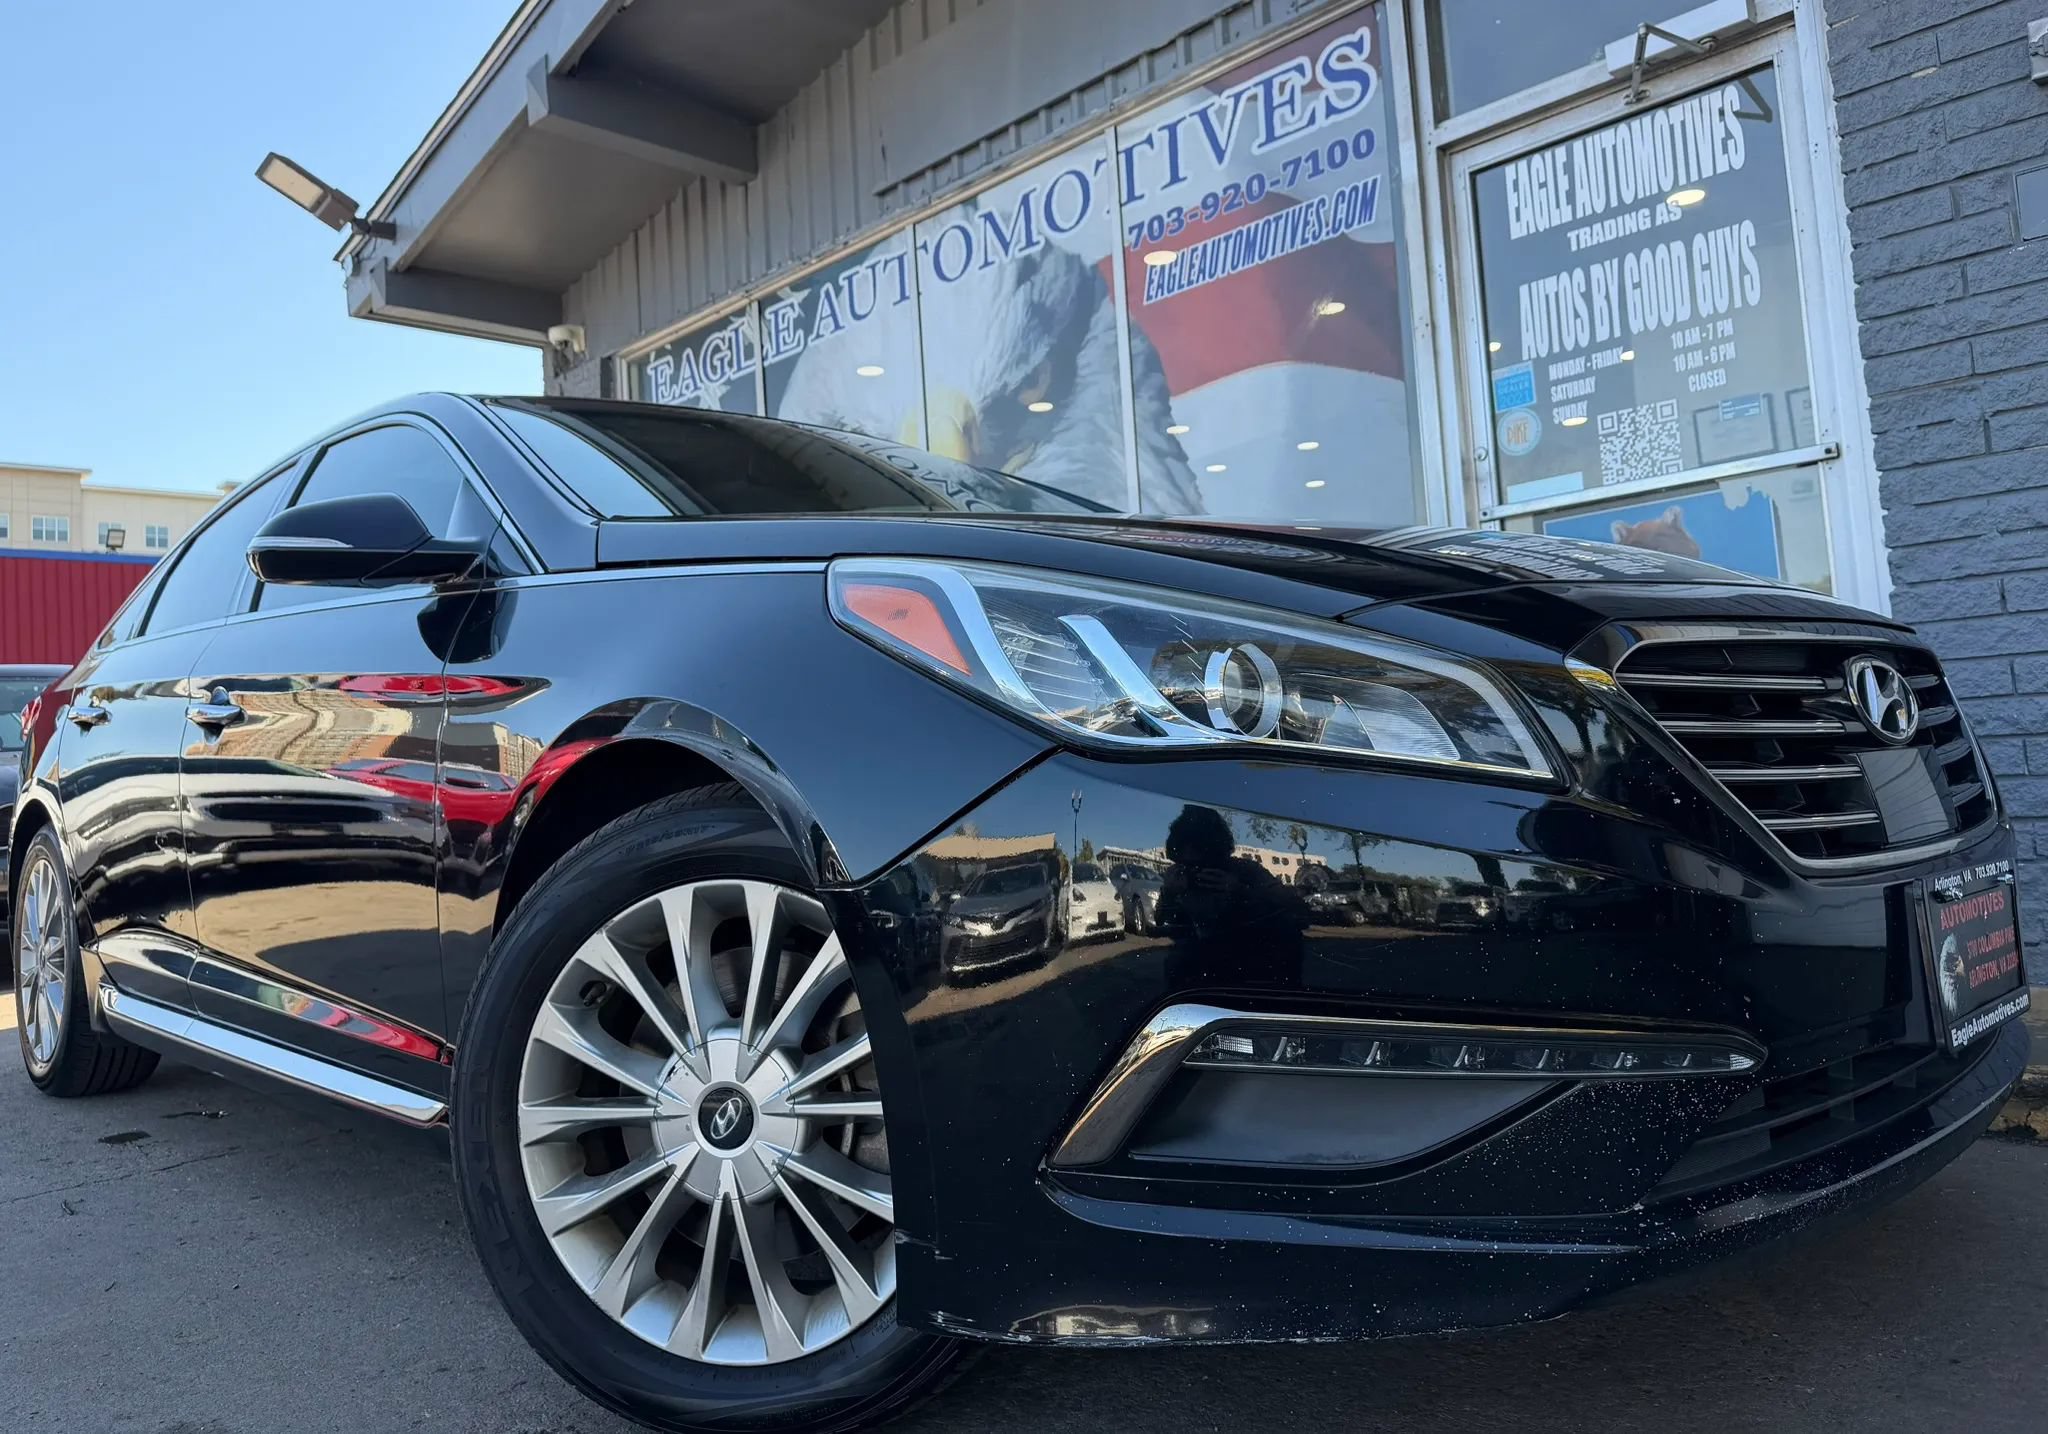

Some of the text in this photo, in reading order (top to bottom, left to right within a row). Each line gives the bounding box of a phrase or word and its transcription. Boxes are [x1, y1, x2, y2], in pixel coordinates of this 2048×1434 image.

[1505, 85, 1746, 240] EAGLE AUTOMOTIVES
[1127, 128, 1376, 250] 703-920-7100
[648, 27, 1377, 404] EAGLE AUTOMOTIVES
[1567, 201, 1682, 252] TRADING AS
[1143, 174, 1381, 305] EAGLEAUTOMOTIVES.COM
[1519, 219, 1761, 361] AUTOS BY GOOD GUYS
[1670, 330, 1684, 350] 10
[1684, 326, 1701, 347] AM
[1706, 322, 1714, 340] 7
[1716, 317, 1734, 339] PM
[1548, 355, 1586, 381] MONDAY
[1591, 346, 1623, 371] FRIDAY
[1672, 353, 1686, 373] 10
[1687, 349, 1704, 371] AM
[1710, 345, 1718, 364] 6
[1718, 341, 1736, 362] PM
[1550, 375, 1596, 403] SATURDAY
[1688, 367, 1727, 393] CLOSED
[1552, 400, 1588, 425] SUNDAY
[1934, 869, 1963, 892] Arlington,
[1962, 868, 1972, 884] VA
[1940, 889, 2005, 930] AUTOMOTIVES
[1950, 993, 2030, 1048] EagleAutomotives.com
